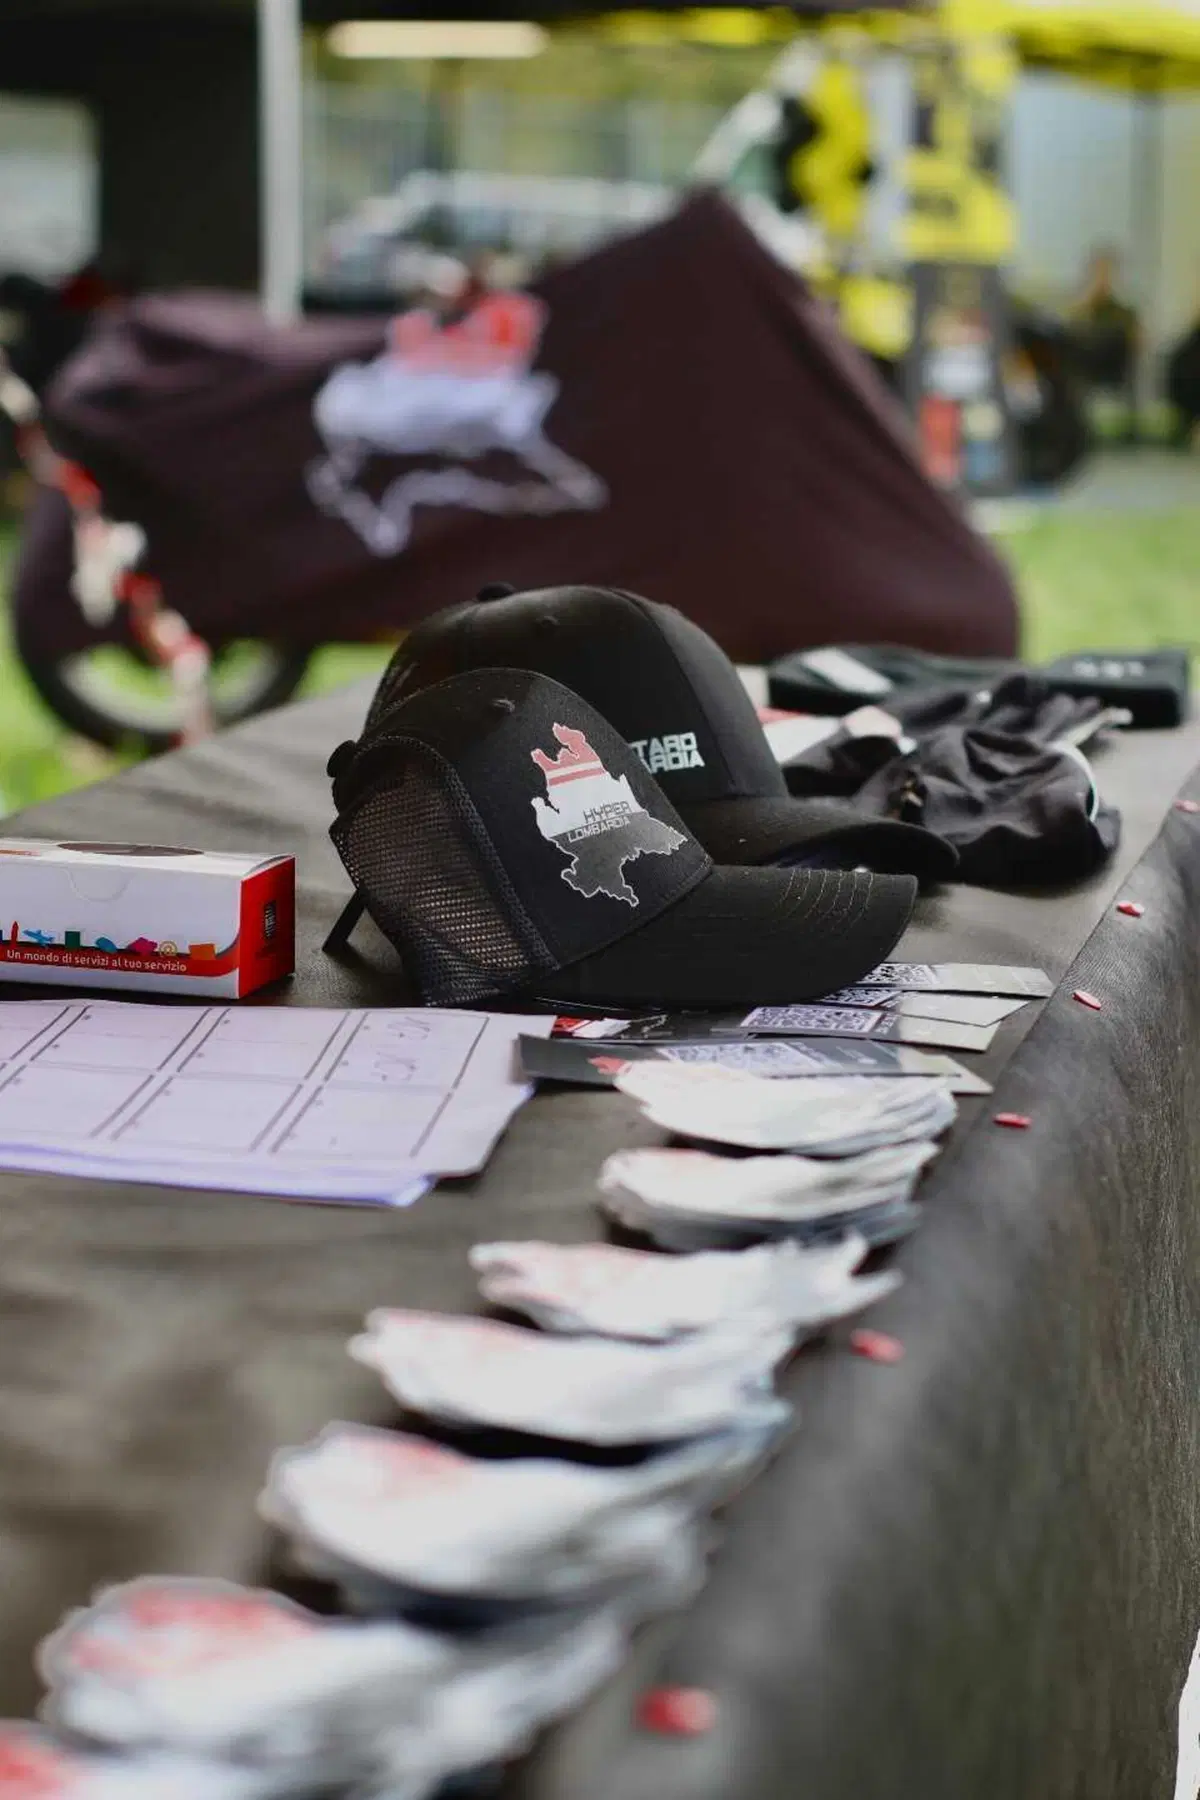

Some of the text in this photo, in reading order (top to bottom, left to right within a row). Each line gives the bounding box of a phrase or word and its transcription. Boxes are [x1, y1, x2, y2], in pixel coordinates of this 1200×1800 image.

[583, 800, 632, 824] HYPER
[567, 815, 631, 843] LOMBARDIA
[6, 949, 187, 972] Un mondo di servizi al tuo servizio
